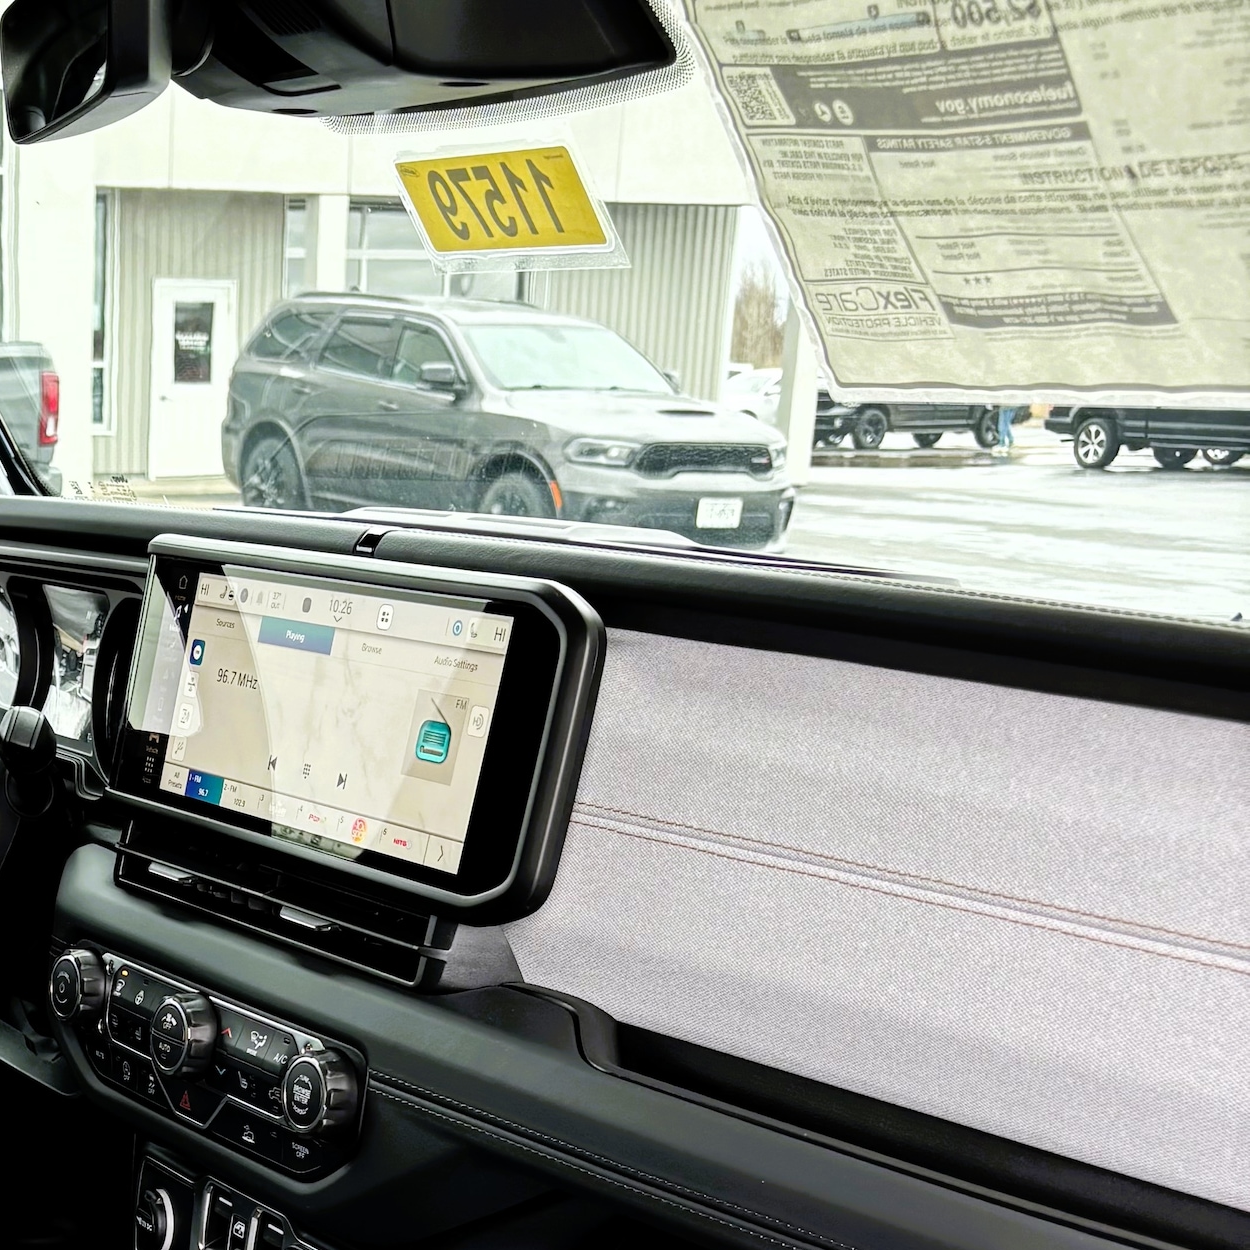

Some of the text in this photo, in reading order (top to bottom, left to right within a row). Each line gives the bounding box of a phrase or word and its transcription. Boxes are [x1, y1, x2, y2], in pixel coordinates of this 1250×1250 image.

[1019, 164, 1136, 185] INSTRUCTION
[329, 599, 353, 615] 10:26
[216, 618, 235, 630] Sources
[285, 629, 305, 643] Playing
[361, 642, 382, 655] Browse
[434, 655, 478, 672] Audio Settings
[216, 667, 259, 690] 96.7 MHz
[455, 699, 468, 711] FM
[273, 1052, 288, 1065] A/C
[291, 1141, 310, 1155] SCREEN
